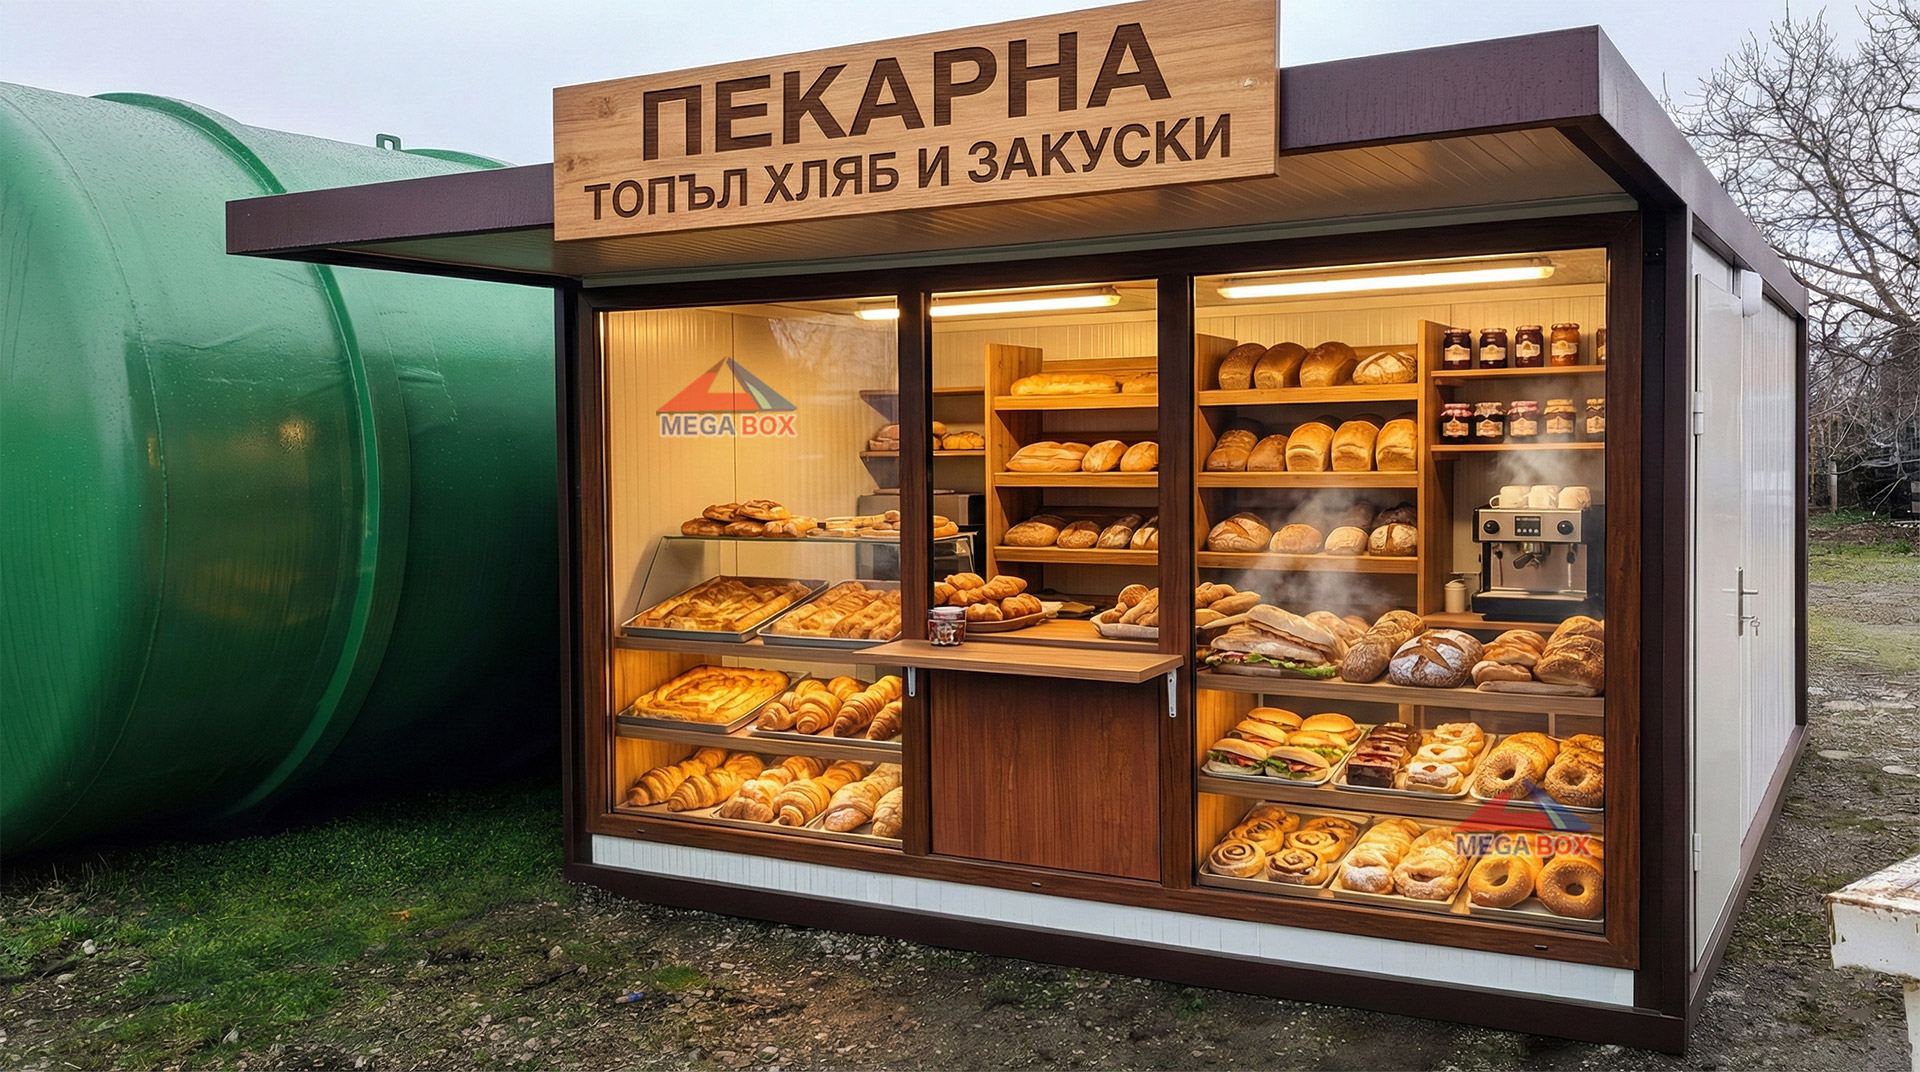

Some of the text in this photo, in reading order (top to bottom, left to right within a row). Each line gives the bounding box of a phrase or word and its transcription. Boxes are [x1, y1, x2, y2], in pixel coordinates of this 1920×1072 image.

[642, 22, 1172, 162] ПЕКАРНА
[584, 113, 1233, 221] ТОПЪЛ ХЛЯБ И ЗАКУСКИ
